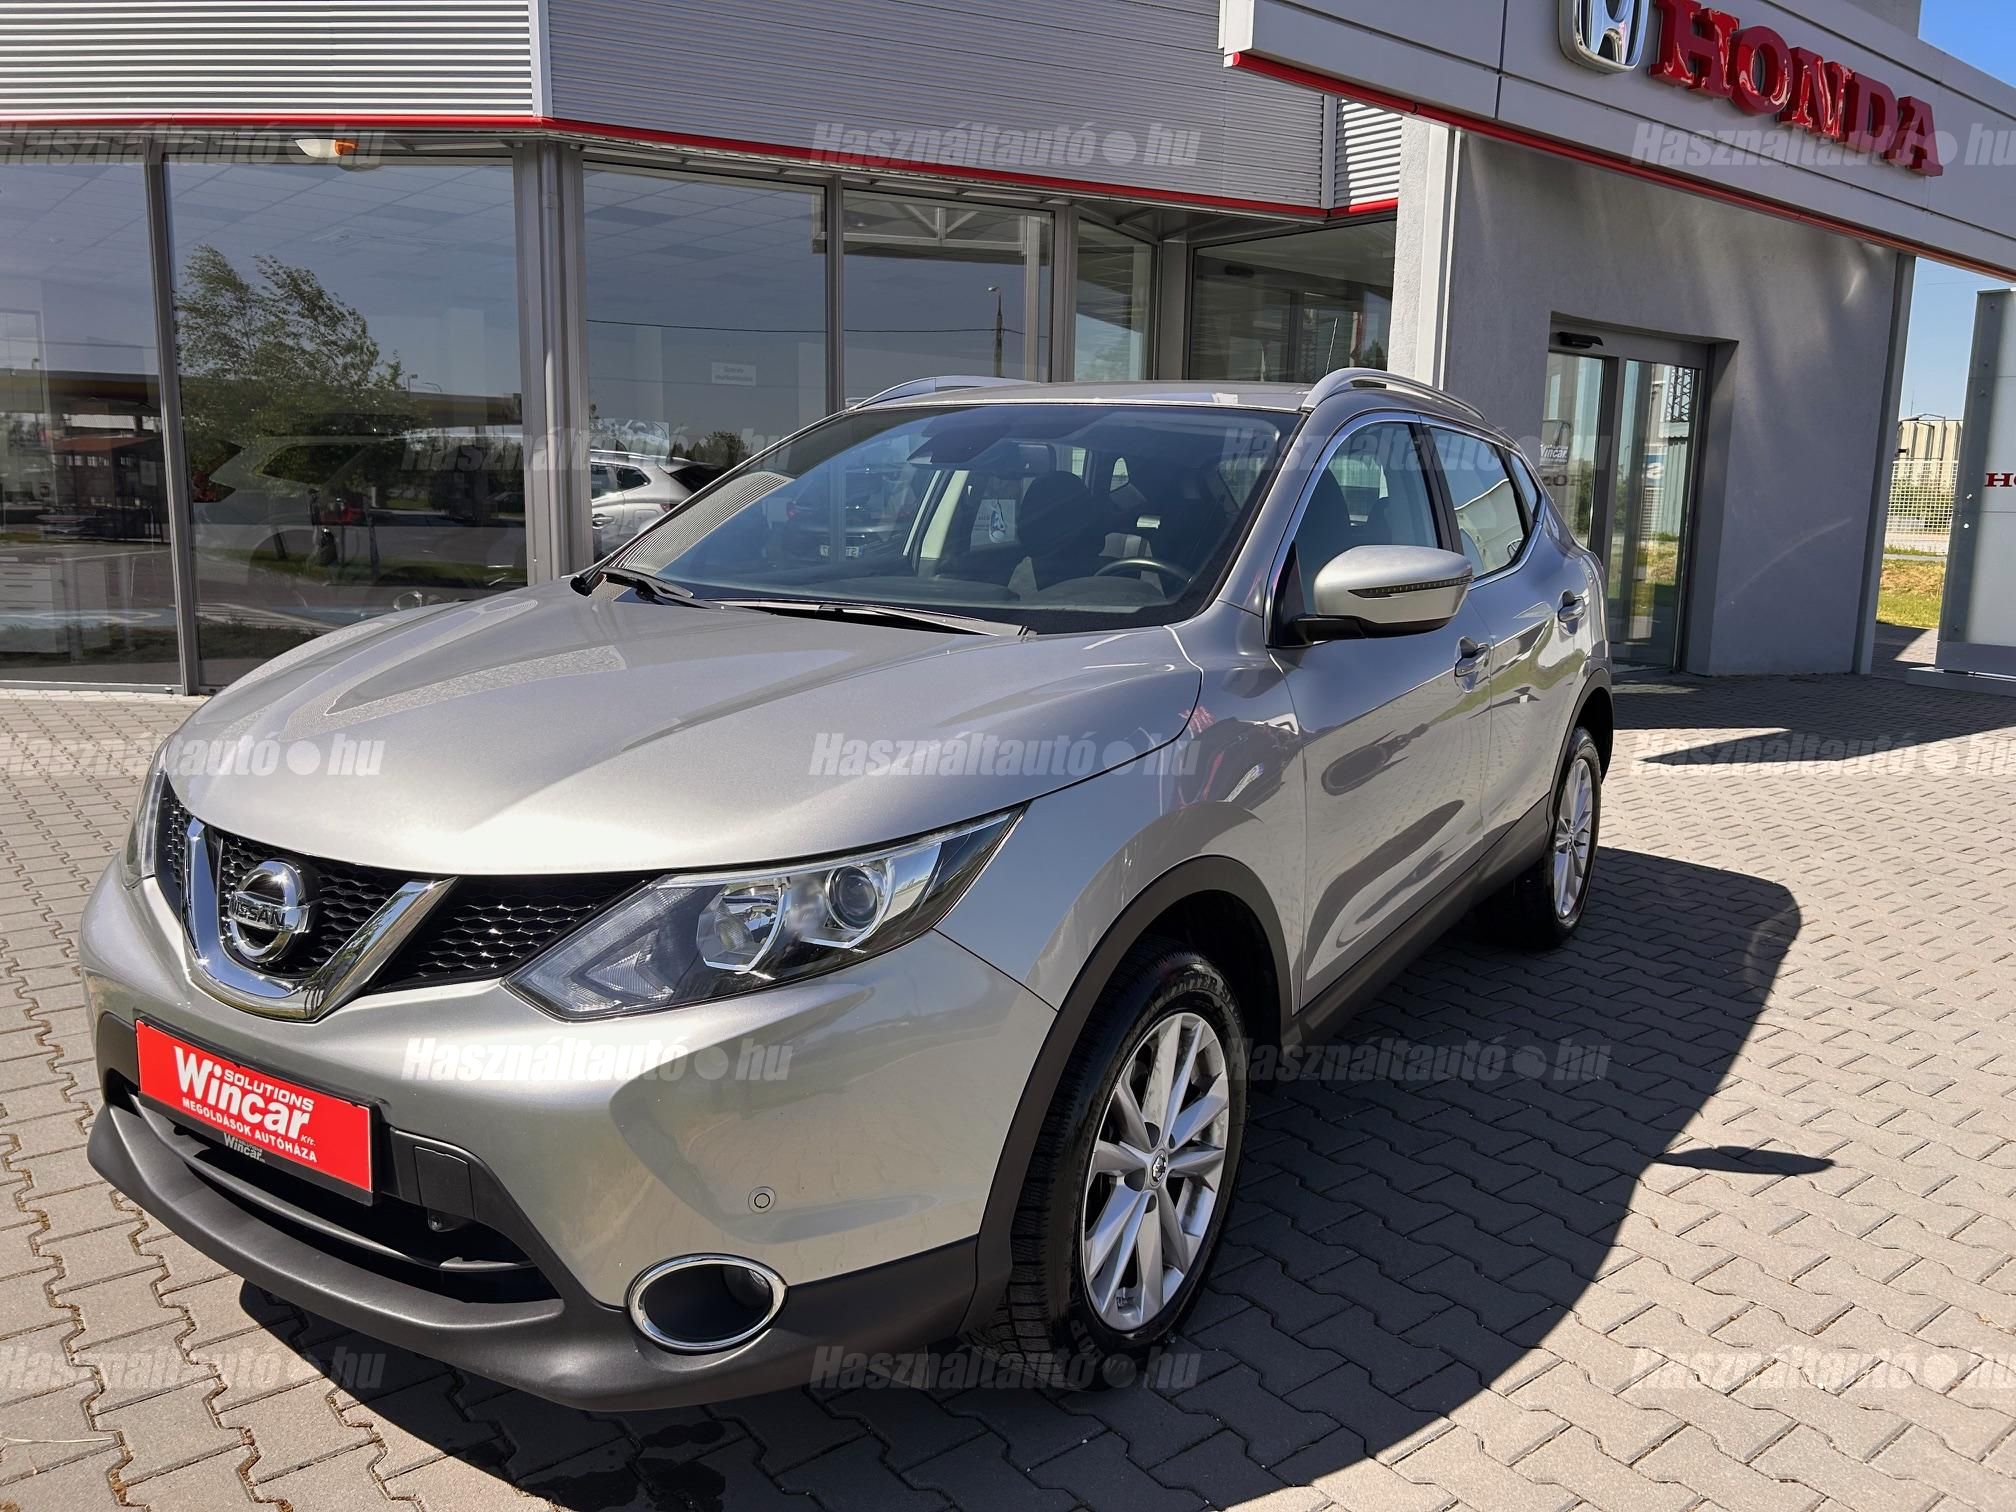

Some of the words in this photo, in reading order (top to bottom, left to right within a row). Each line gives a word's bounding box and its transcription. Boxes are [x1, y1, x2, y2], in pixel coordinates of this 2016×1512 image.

[1649, 0, 1943, 176] HONDA
[1984, 472, 2016, 488] H
[174, 1045, 310, 1140] Wincar
[300, 1133, 316, 1147] Kft.
[224, 1069, 314, 1111] SOLUTIONS
[182, 1096, 252, 1138] MEGOLDÁSOK
[255, 1128, 318, 1163] AUTÓHÁZA
[223, 1132, 263, 1161] Wincar
